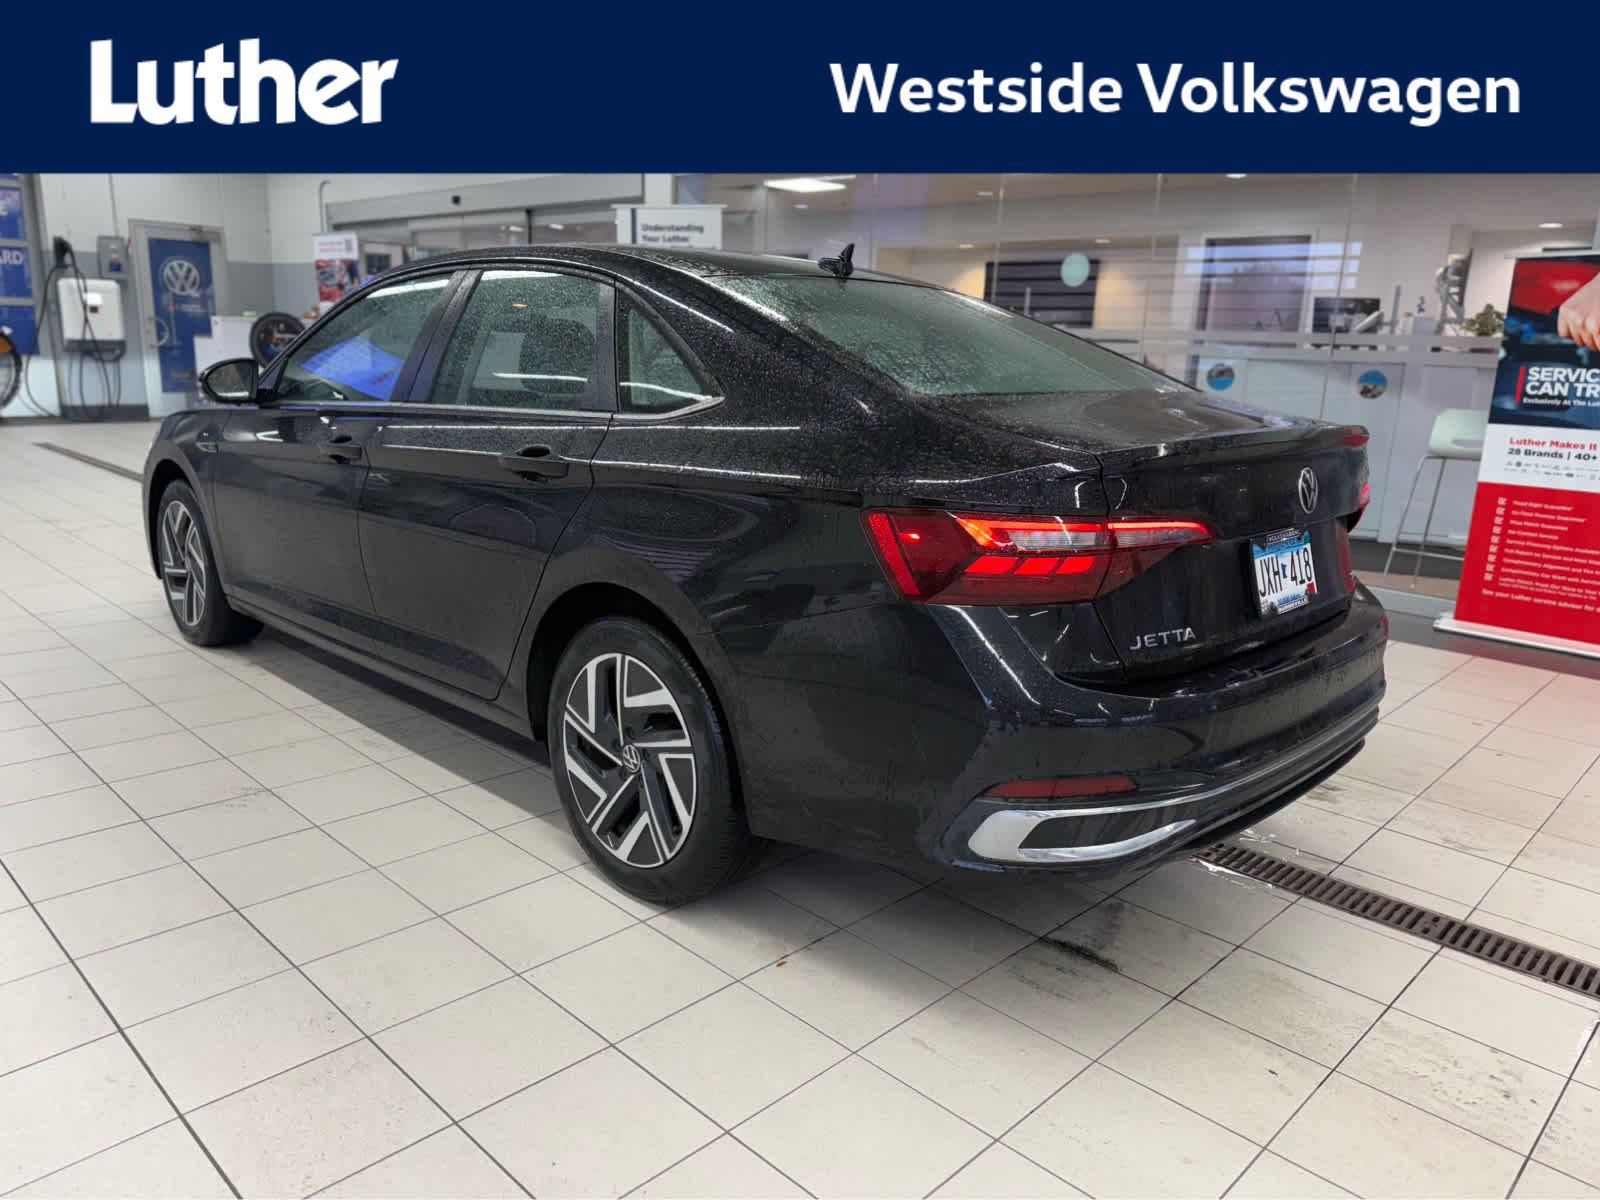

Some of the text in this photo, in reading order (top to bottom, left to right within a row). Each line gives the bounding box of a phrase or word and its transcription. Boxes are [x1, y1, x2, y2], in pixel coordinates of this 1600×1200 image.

[1525, 381, 1569, 396] CAN
[1509, 437, 1598, 451] Luther Makes It
[1507, 447, 1521, 456] 28
[1523, 448, 1563, 459] Brands
[1259, 547, 1313, 597] JXH 418
[1129, 627, 1196, 651] JETTA
